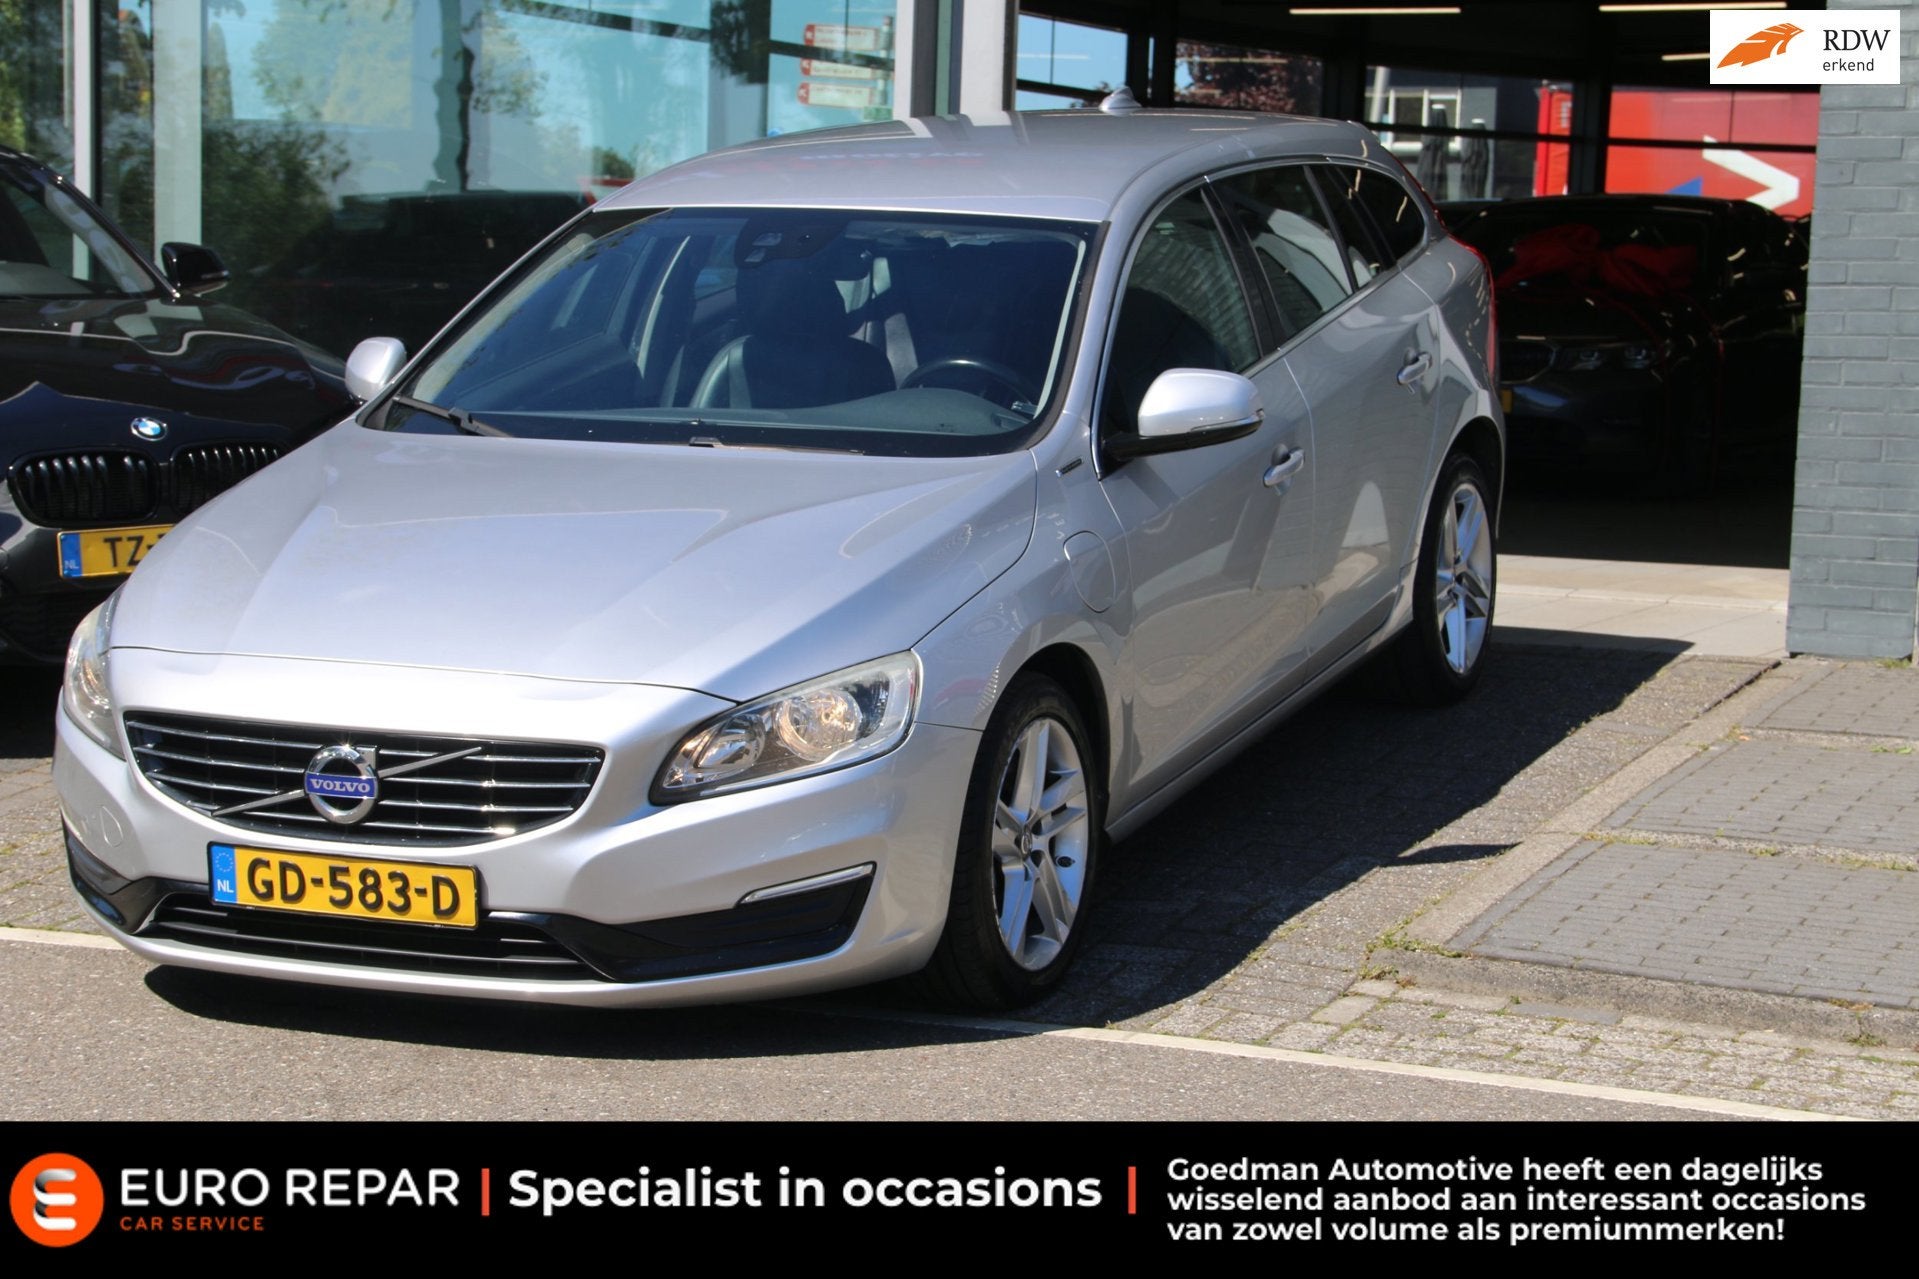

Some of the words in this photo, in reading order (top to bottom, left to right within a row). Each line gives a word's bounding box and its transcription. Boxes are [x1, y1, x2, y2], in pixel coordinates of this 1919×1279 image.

[64, 560, 79, 570] NL
[309, 777, 371, 794] VOLVO
[217, 878, 234, 893] NL
[247, 857, 461, 919] GD-583-D
